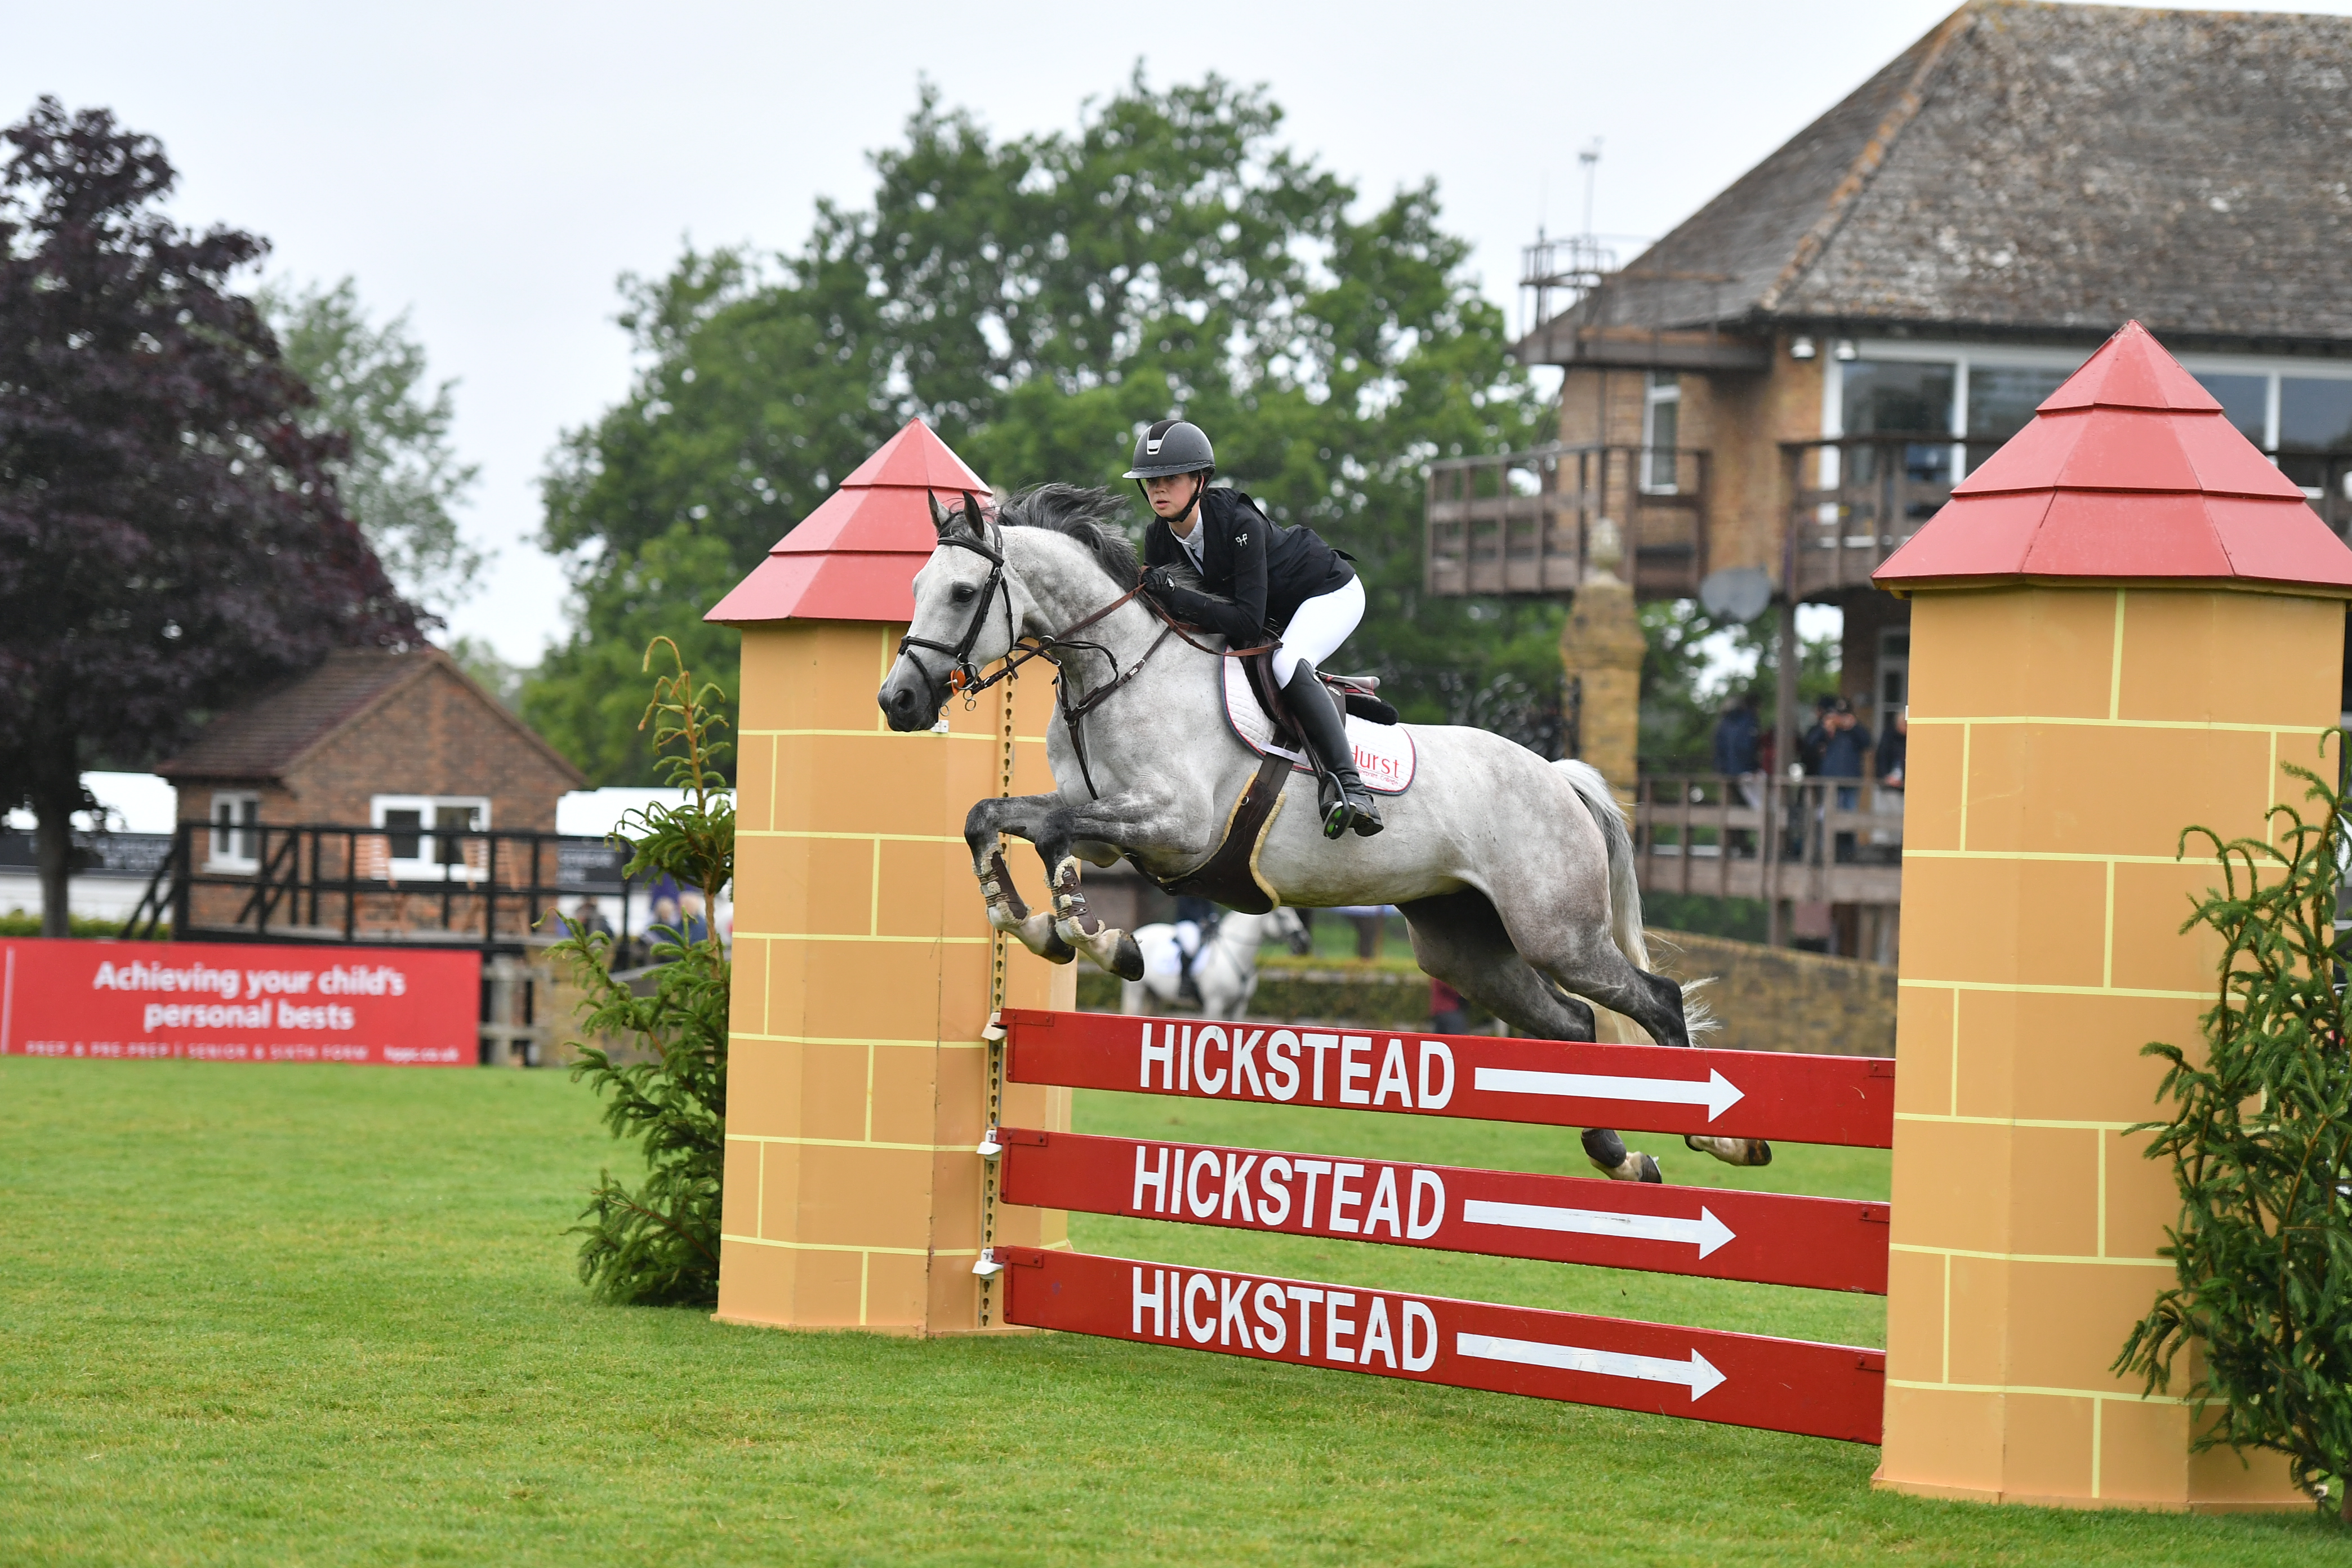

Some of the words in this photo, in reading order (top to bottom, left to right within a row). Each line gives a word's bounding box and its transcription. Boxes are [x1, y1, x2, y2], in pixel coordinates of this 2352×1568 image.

[1380, 775, 1398, 786] College
[93, 960, 240, 999] Achieving
[246, 969, 313, 1000] your
[318, 964, 407, 996] child's
[143, 999, 271, 1032] personal
[277, 999, 355, 1030] bests
[25, 1040, 67, 1057] PREP
[188, 1043, 248, 1060] SENIOR
[322, 1044, 369, 1061] FORM
[1140, 1023, 1455, 1110] HICKSTEAD
[1133, 1145, 1446, 1240] HICKSTEAD
[1133, 1267, 1438, 1373] HICKSTEAD
